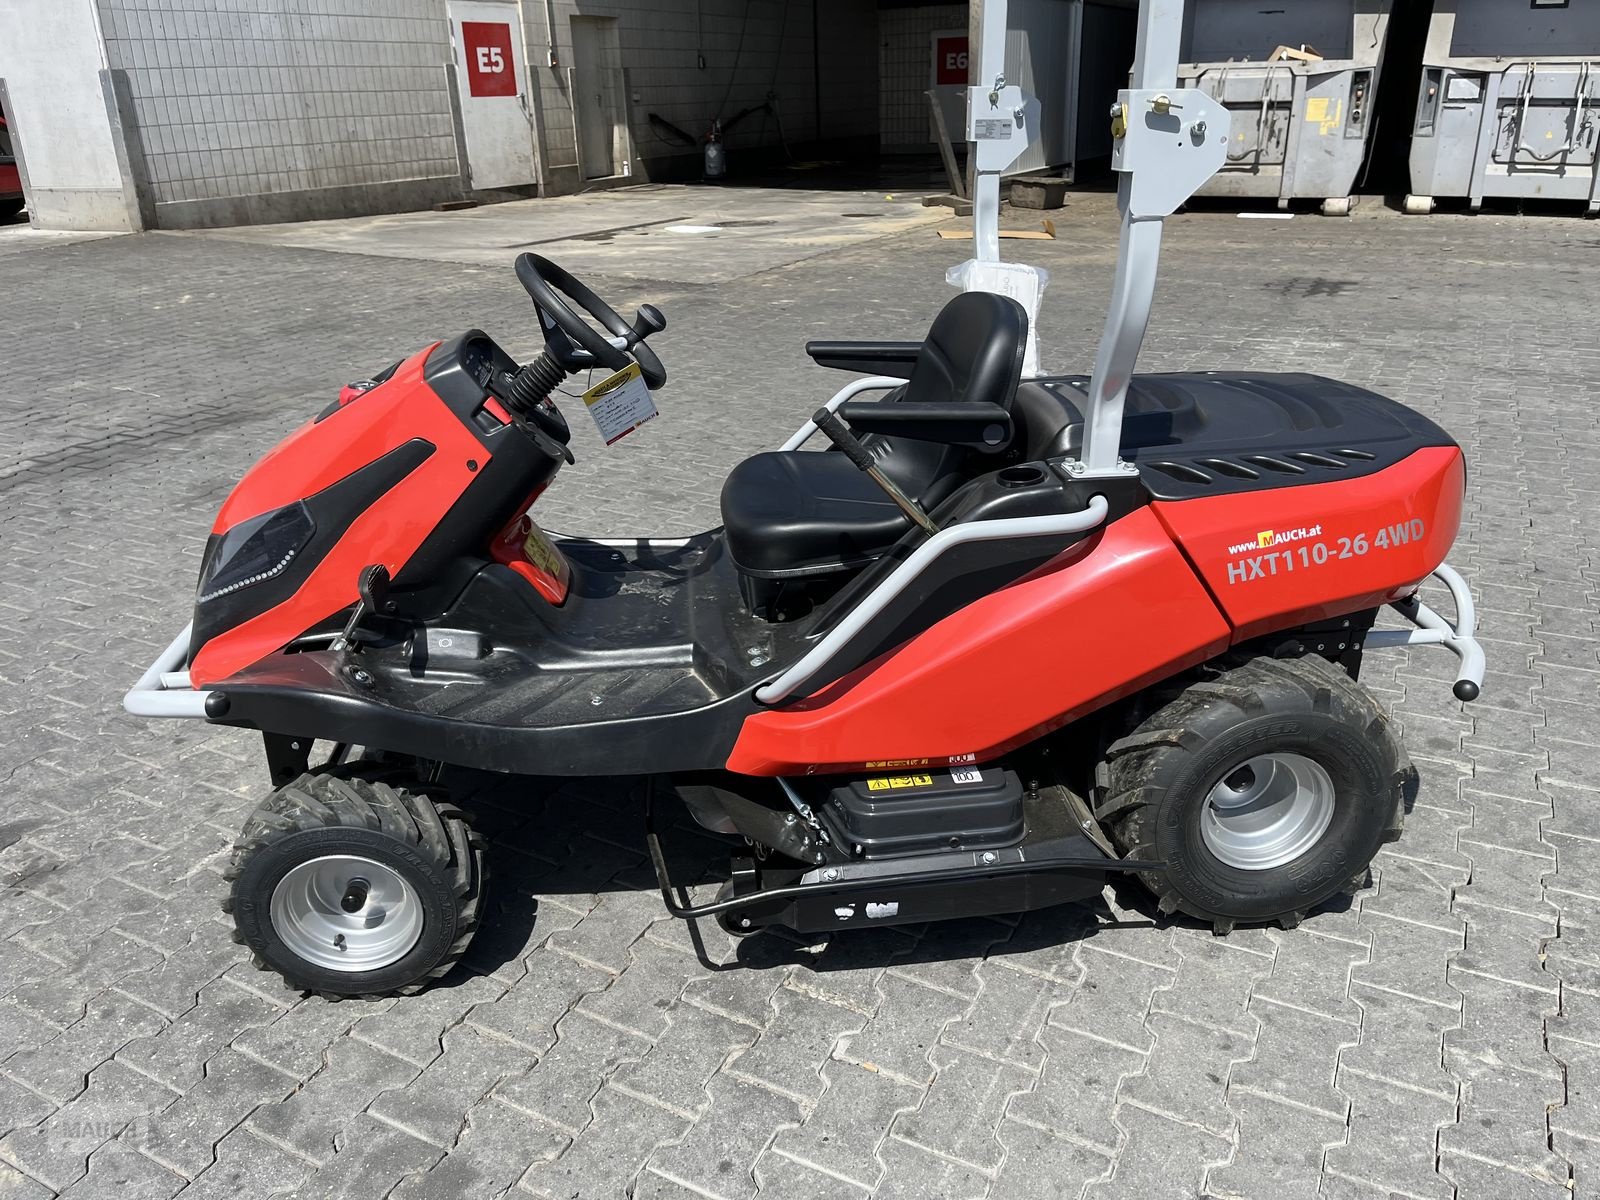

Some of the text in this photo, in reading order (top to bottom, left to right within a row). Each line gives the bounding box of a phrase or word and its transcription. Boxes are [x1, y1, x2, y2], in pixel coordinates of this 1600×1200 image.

[476, 47, 504, 73] E5
[946, 52, 968, 69] E6
[1227, 518, 1425, 584] HXT110-26 4WD
[1228, 524, 1322, 555] www.MAUCH.at
[954, 771, 974, 782] 100
